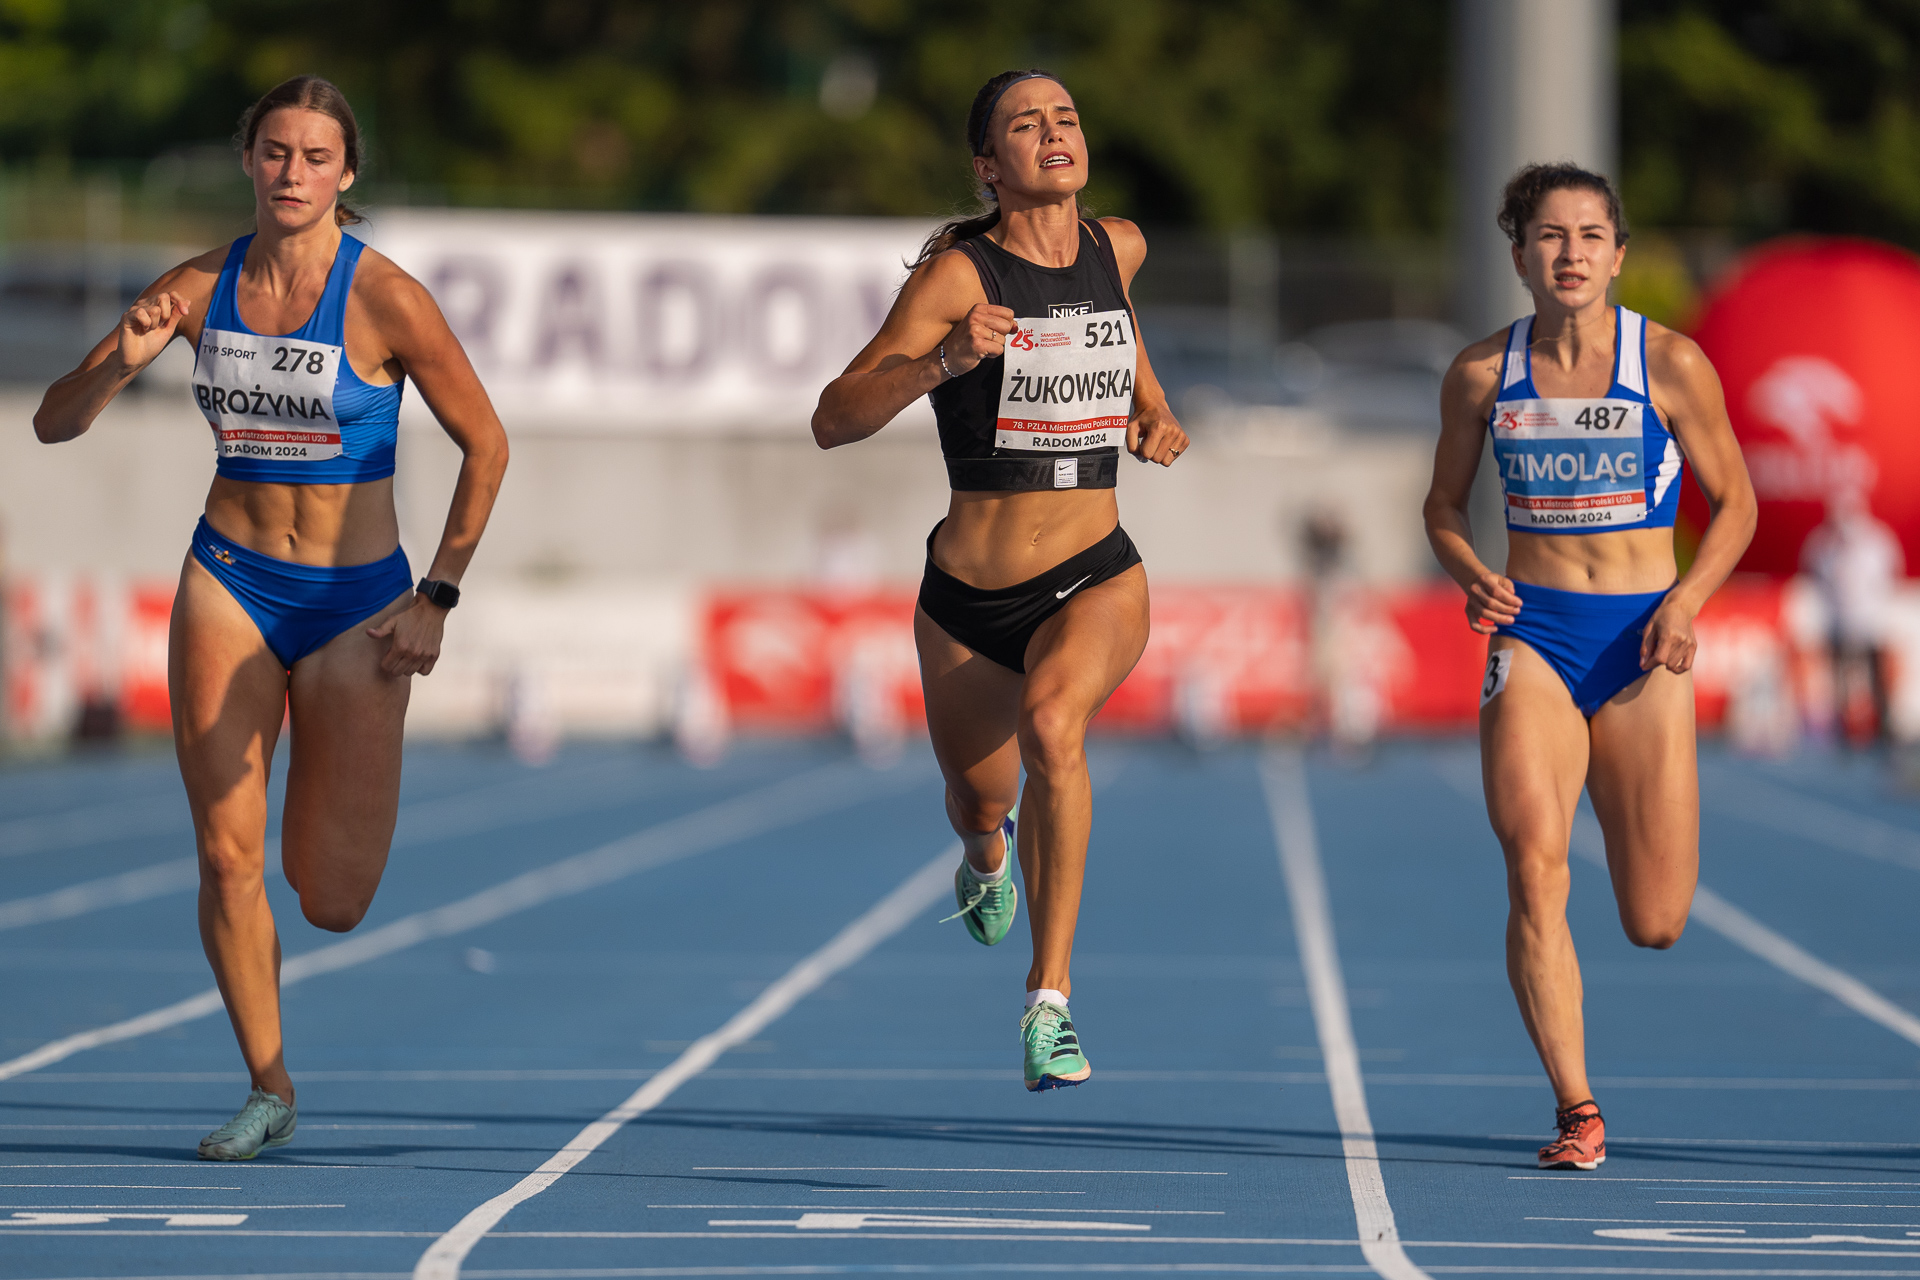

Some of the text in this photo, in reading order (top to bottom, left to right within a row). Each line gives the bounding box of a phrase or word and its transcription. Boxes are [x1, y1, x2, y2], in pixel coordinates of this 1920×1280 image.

[428, 254, 896, 382] RADO
[1084, 320, 1127, 348] 521
[203, 345, 257, 361] TVP SPORT
[271, 346, 325, 375] 278
[1007, 368, 1132, 404] ŻUKOWSKA
[196, 383, 332, 421] BROŻYNA
[1012, 418, 1128, 432] 78. PZLA Mistrzostwa Polski U20
[1574, 407, 1629, 430] 487
[220, 431, 328, 443] ZLA Mistrzostwa Polski U20
[1032, 433, 1107, 448] RADOM 2024
[225, 445, 307, 457] RADOM 2024
[1009, 461, 1095, 485] NIE
[1503, 452, 1637, 483] ZIMOLĄG
[1542, 497, 1589, 509] Mistrzostwa
[1590, 495, 1615, 506] Polski
[1616, 495, 1632, 504] U20
[1531, 511, 1612, 524] RADOM 2024
[1484, 655, 1500, 698] 3
